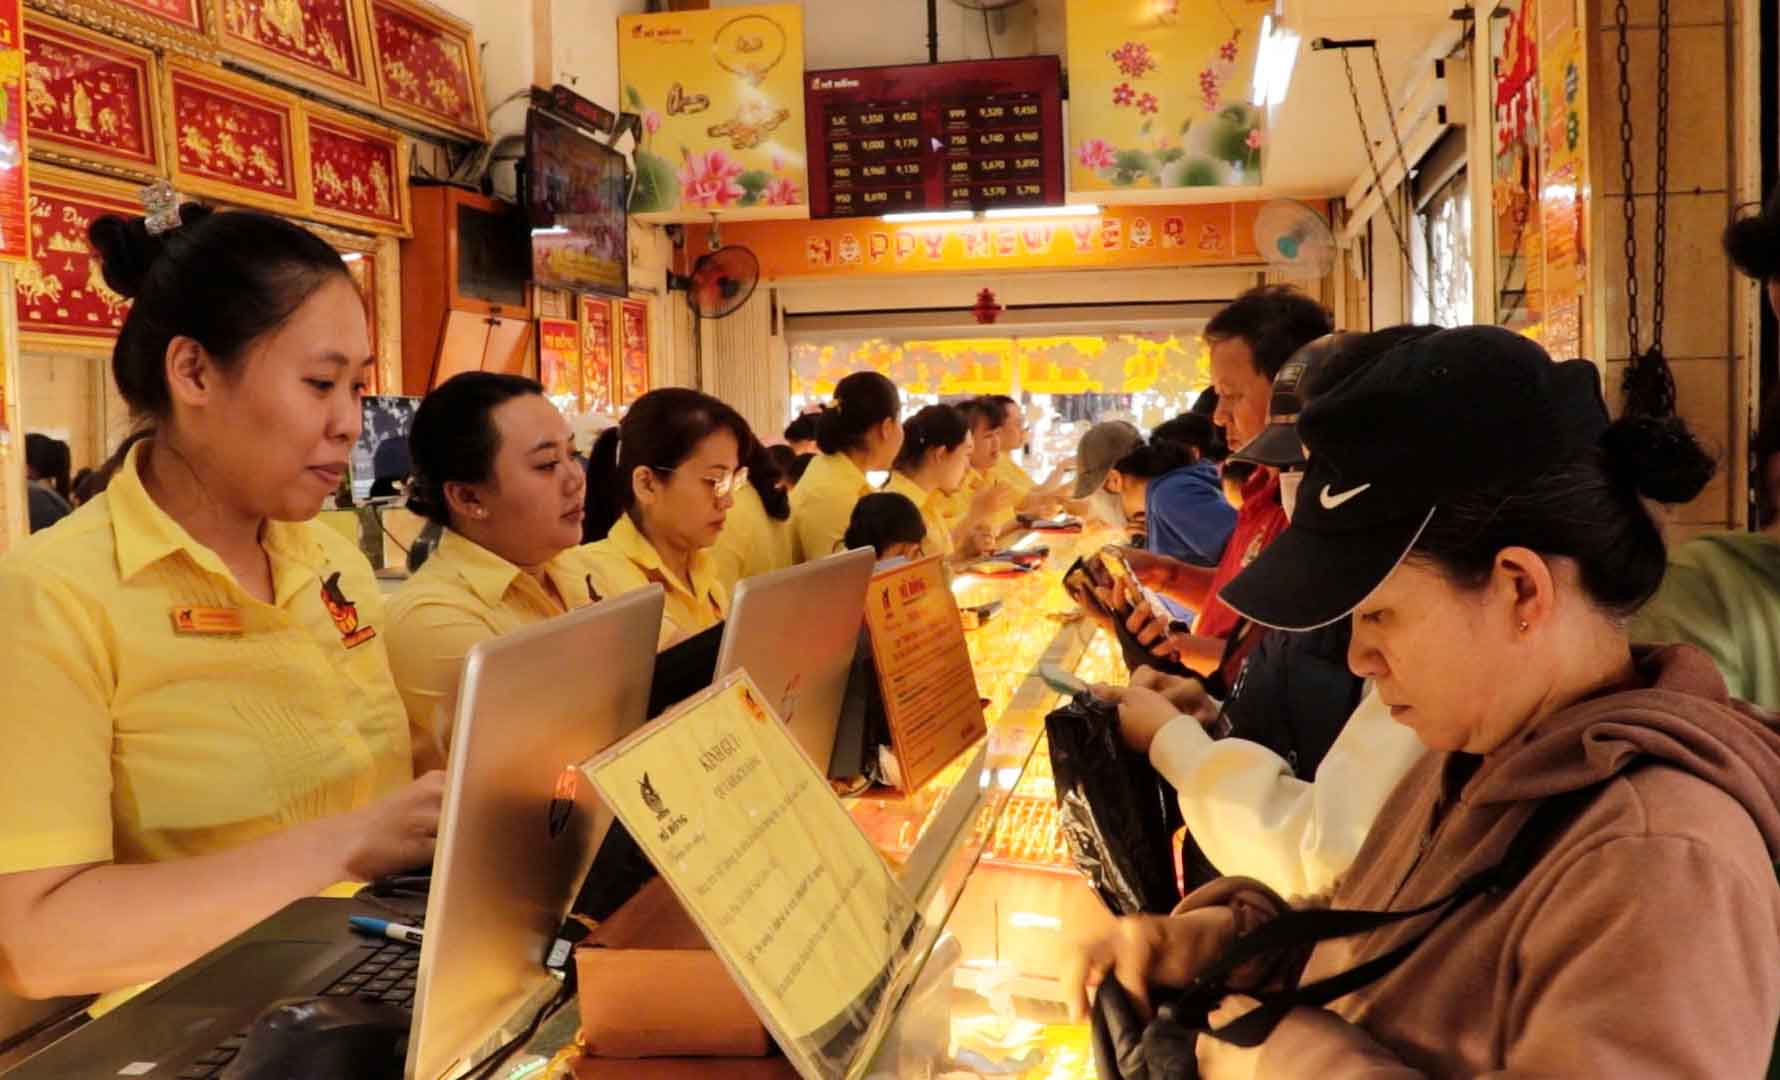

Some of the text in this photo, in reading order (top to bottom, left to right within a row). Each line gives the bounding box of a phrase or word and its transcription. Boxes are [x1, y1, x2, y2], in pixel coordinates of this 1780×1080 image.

[806, 214, 1186, 266] HAPPY NEW YEAR
